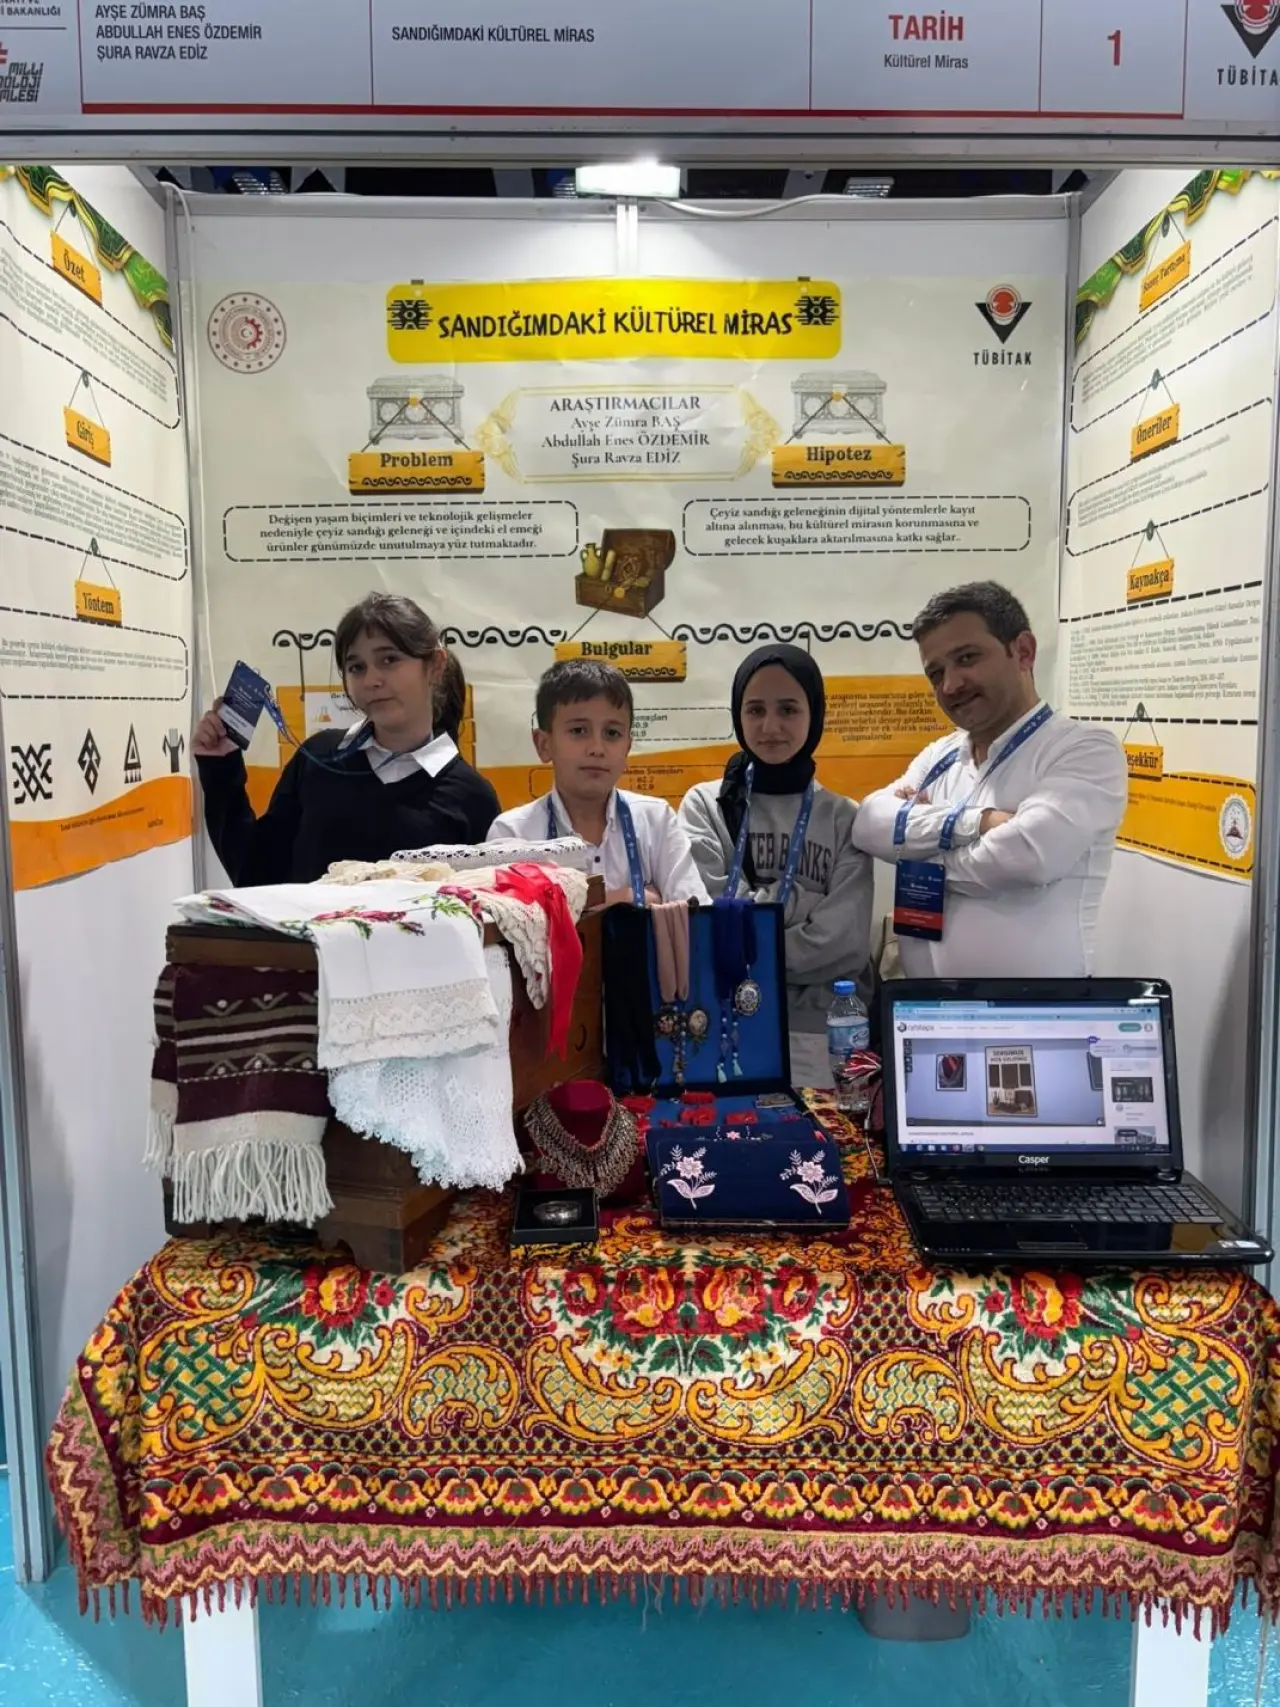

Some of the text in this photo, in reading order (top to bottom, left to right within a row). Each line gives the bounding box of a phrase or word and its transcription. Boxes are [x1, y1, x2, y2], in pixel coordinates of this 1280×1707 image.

[7, 5, 61, 16] BAKANLIĞI
[95, 3, 205, 22] AYŞE ZÜMRA BAŞ
[96, 23, 262, 39] ABDULLAH ENES ÖZDEMİR
[392, 24, 595, 42] SANDIĞIMDAKİ KÜLTÜREL MİRAS
[888, 10, 964, 41] TARİH
[97, 43, 208, 62] ŞURA RAVZA EDİZ
[1107, 30, 1122, 66] 1
[884, 54, 969, 69] Kültürel Miras
[63, 249, 86, 283] Özet
[439, 306, 793, 338] SANDIĞIMDAKİ KÜLTÜREL MİRAS
[973, 349, 1032, 366] TÜBİTAK
[550, 396, 701, 413] ARAŞTIRMACILAR
[571, 415, 681, 431] Ayşe Zümra BAŞ
[1136, 414, 1172, 446] Öneriler
[542, 430, 710, 448] Abdullah Enes ÖZDEMİR
[380, 452, 454, 468] Problem
[572, 448, 681, 468] Şura Ravza EDİZ
[806, 445, 873, 465] Hipotez
[268, 514, 312, 526] Değişen
[315, 514, 349, 526] yaşam
[351, 512, 401, 524] biçimleri
[419, 511, 474, 523] teknolojik
[476, 511, 533, 523] gelişmeler
[710, 504, 975, 520] Çeyiz sandığı geleneğinin dijital yöntemlerle kayıt
[260, 527, 313, 538] nedeniyle
[316, 528, 344, 539] çeyiz
[346, 526, 386, 538] sandığı
[388, 525, 433, 537] geleneği
[451, 524, 495, 537] içindeki
[497, 524, 507, 534] el
[509, 524, 543, 535] emeği
[705, 521, 736, 531] altına
[789, 519, 803, 529] bu
[805, 519, 849, 530] kültürel
[851, 519, 893, 529] mirasın
[895, 518, 966, 528] korunmasına
[266, 539, 537, 553] ürünler günümüzde unutulmaya yüz tutmaktadır.
[724, 536, 765, 547] gelecek
[766, 534, 818, 546] kuşaklara
[820, 533, 894, 544] aktarılmasına
[896, 532, 923, 542] katkı
[1129, 567, 1170, 590] Kaynakça
[82, 591, 114, 615] Yöntem
[581, 641, 653, 658] Bulgular
[1126, 751, 1159, 771] eşekkür
[779, 833, 832, 885] BNKS
[1018, 1155, 1050, 1166] Casper
